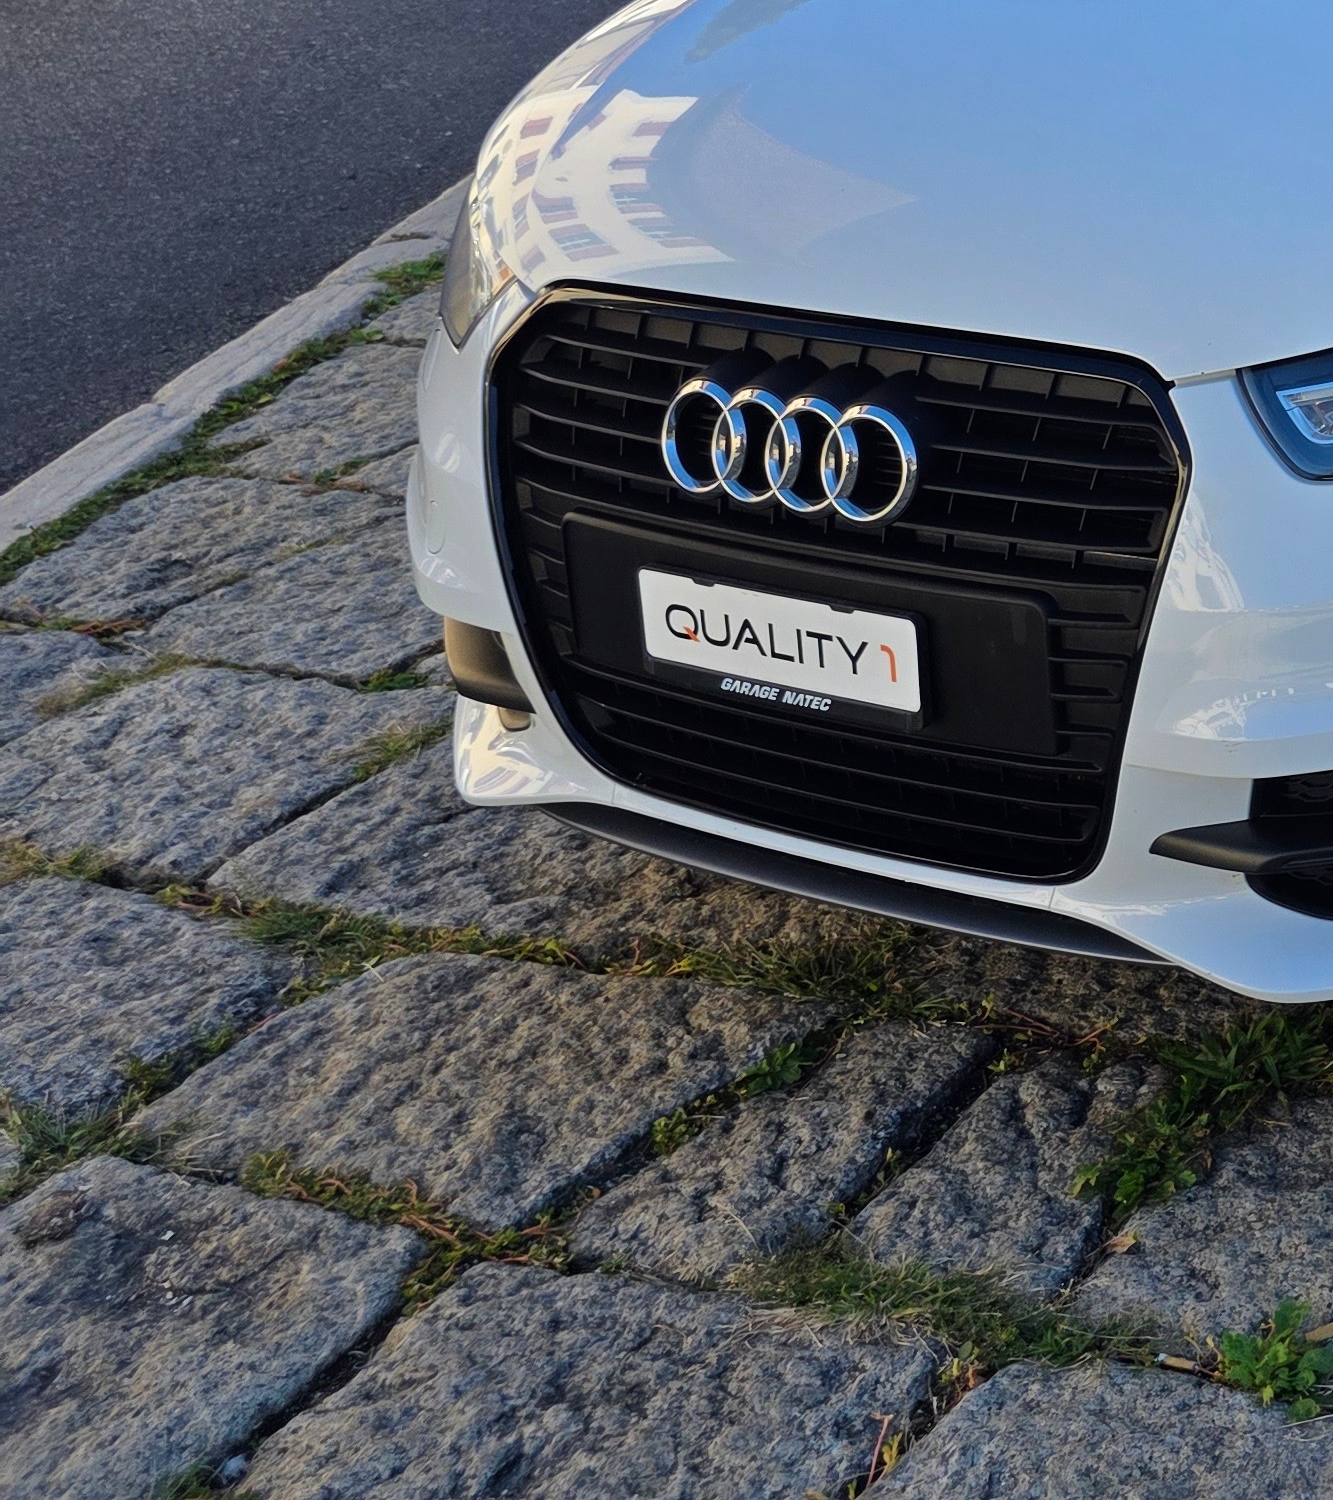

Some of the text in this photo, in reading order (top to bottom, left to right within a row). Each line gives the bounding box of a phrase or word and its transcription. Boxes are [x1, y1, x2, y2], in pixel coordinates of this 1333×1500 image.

[665, 603, 897, 683] QUALITY 1
[720, 677, 832, 712] GARAGE NATEC
